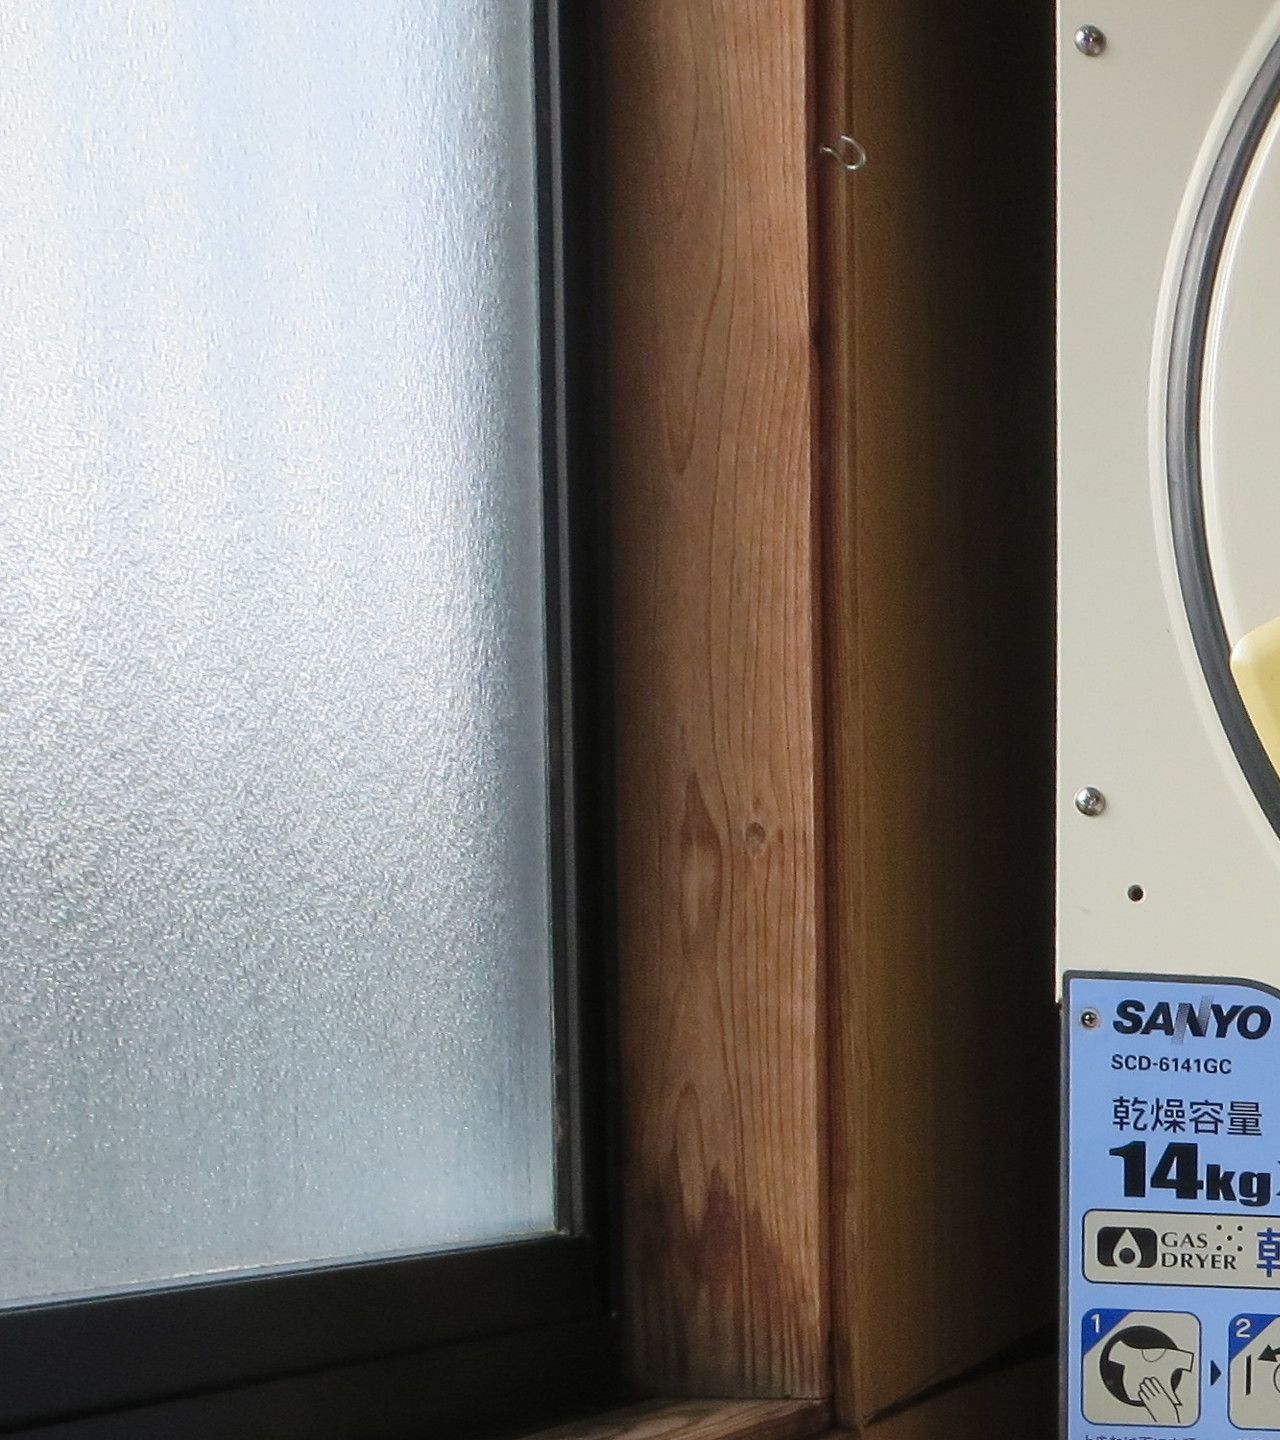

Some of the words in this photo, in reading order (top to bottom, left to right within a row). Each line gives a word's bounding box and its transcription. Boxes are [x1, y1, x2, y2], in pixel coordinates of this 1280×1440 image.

[1112, 998, 1271, 1041] SANYO
[1111, 1054, 1232, 1075] SCD-6141GC
[1112, 1096, 1262, 1137] 乾燥容量
[1161, 1231, 1208, 1249] GAS
[1161, 1252, 1237, 1272] DRYER
[1091, 1314, 1100, 1333] 1
[1236, 1319, 1251, 1338] 2
